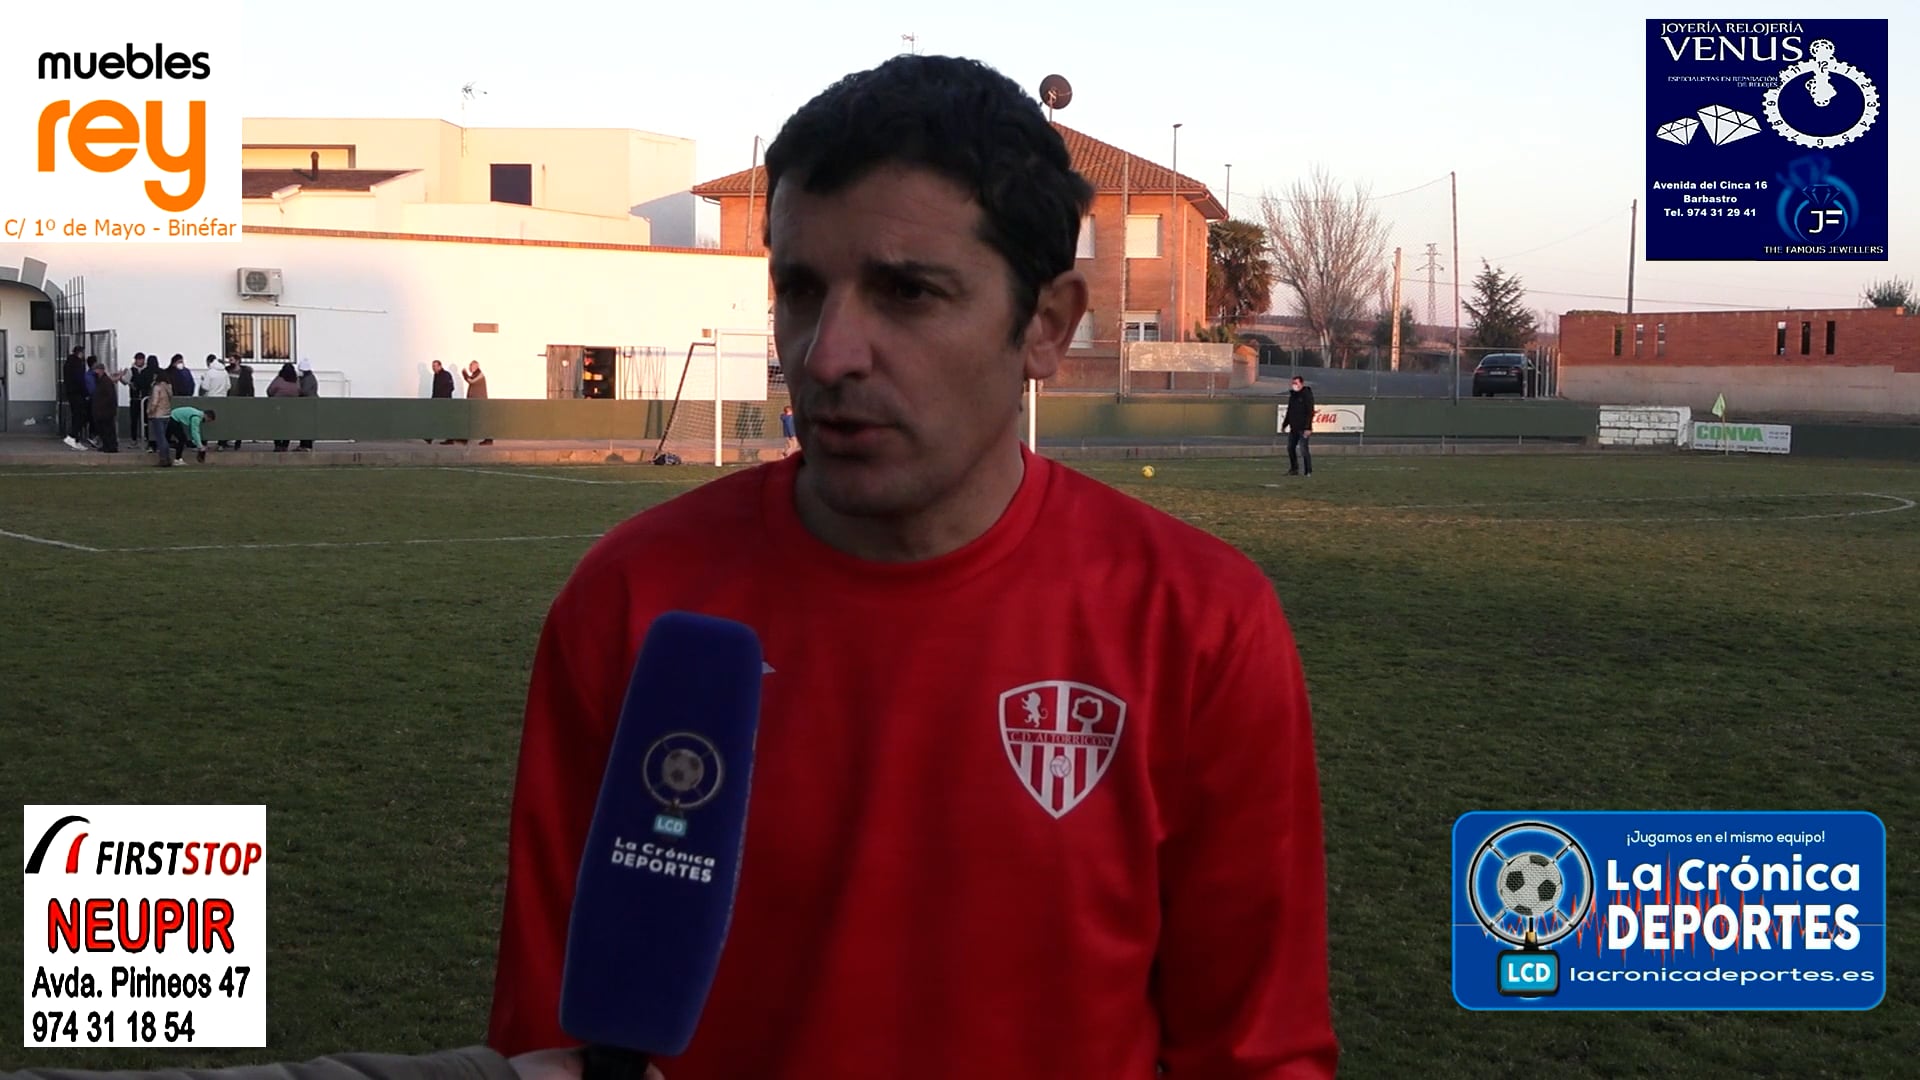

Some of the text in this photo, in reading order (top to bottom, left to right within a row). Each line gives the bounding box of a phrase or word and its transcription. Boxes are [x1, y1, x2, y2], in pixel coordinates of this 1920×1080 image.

[1696, 424, 1763, 442] CONVA
[656, 817, 684, 833] LCD
[614, 836, 637, 851] La
[611, 850, 713, 883] DEPORTES
